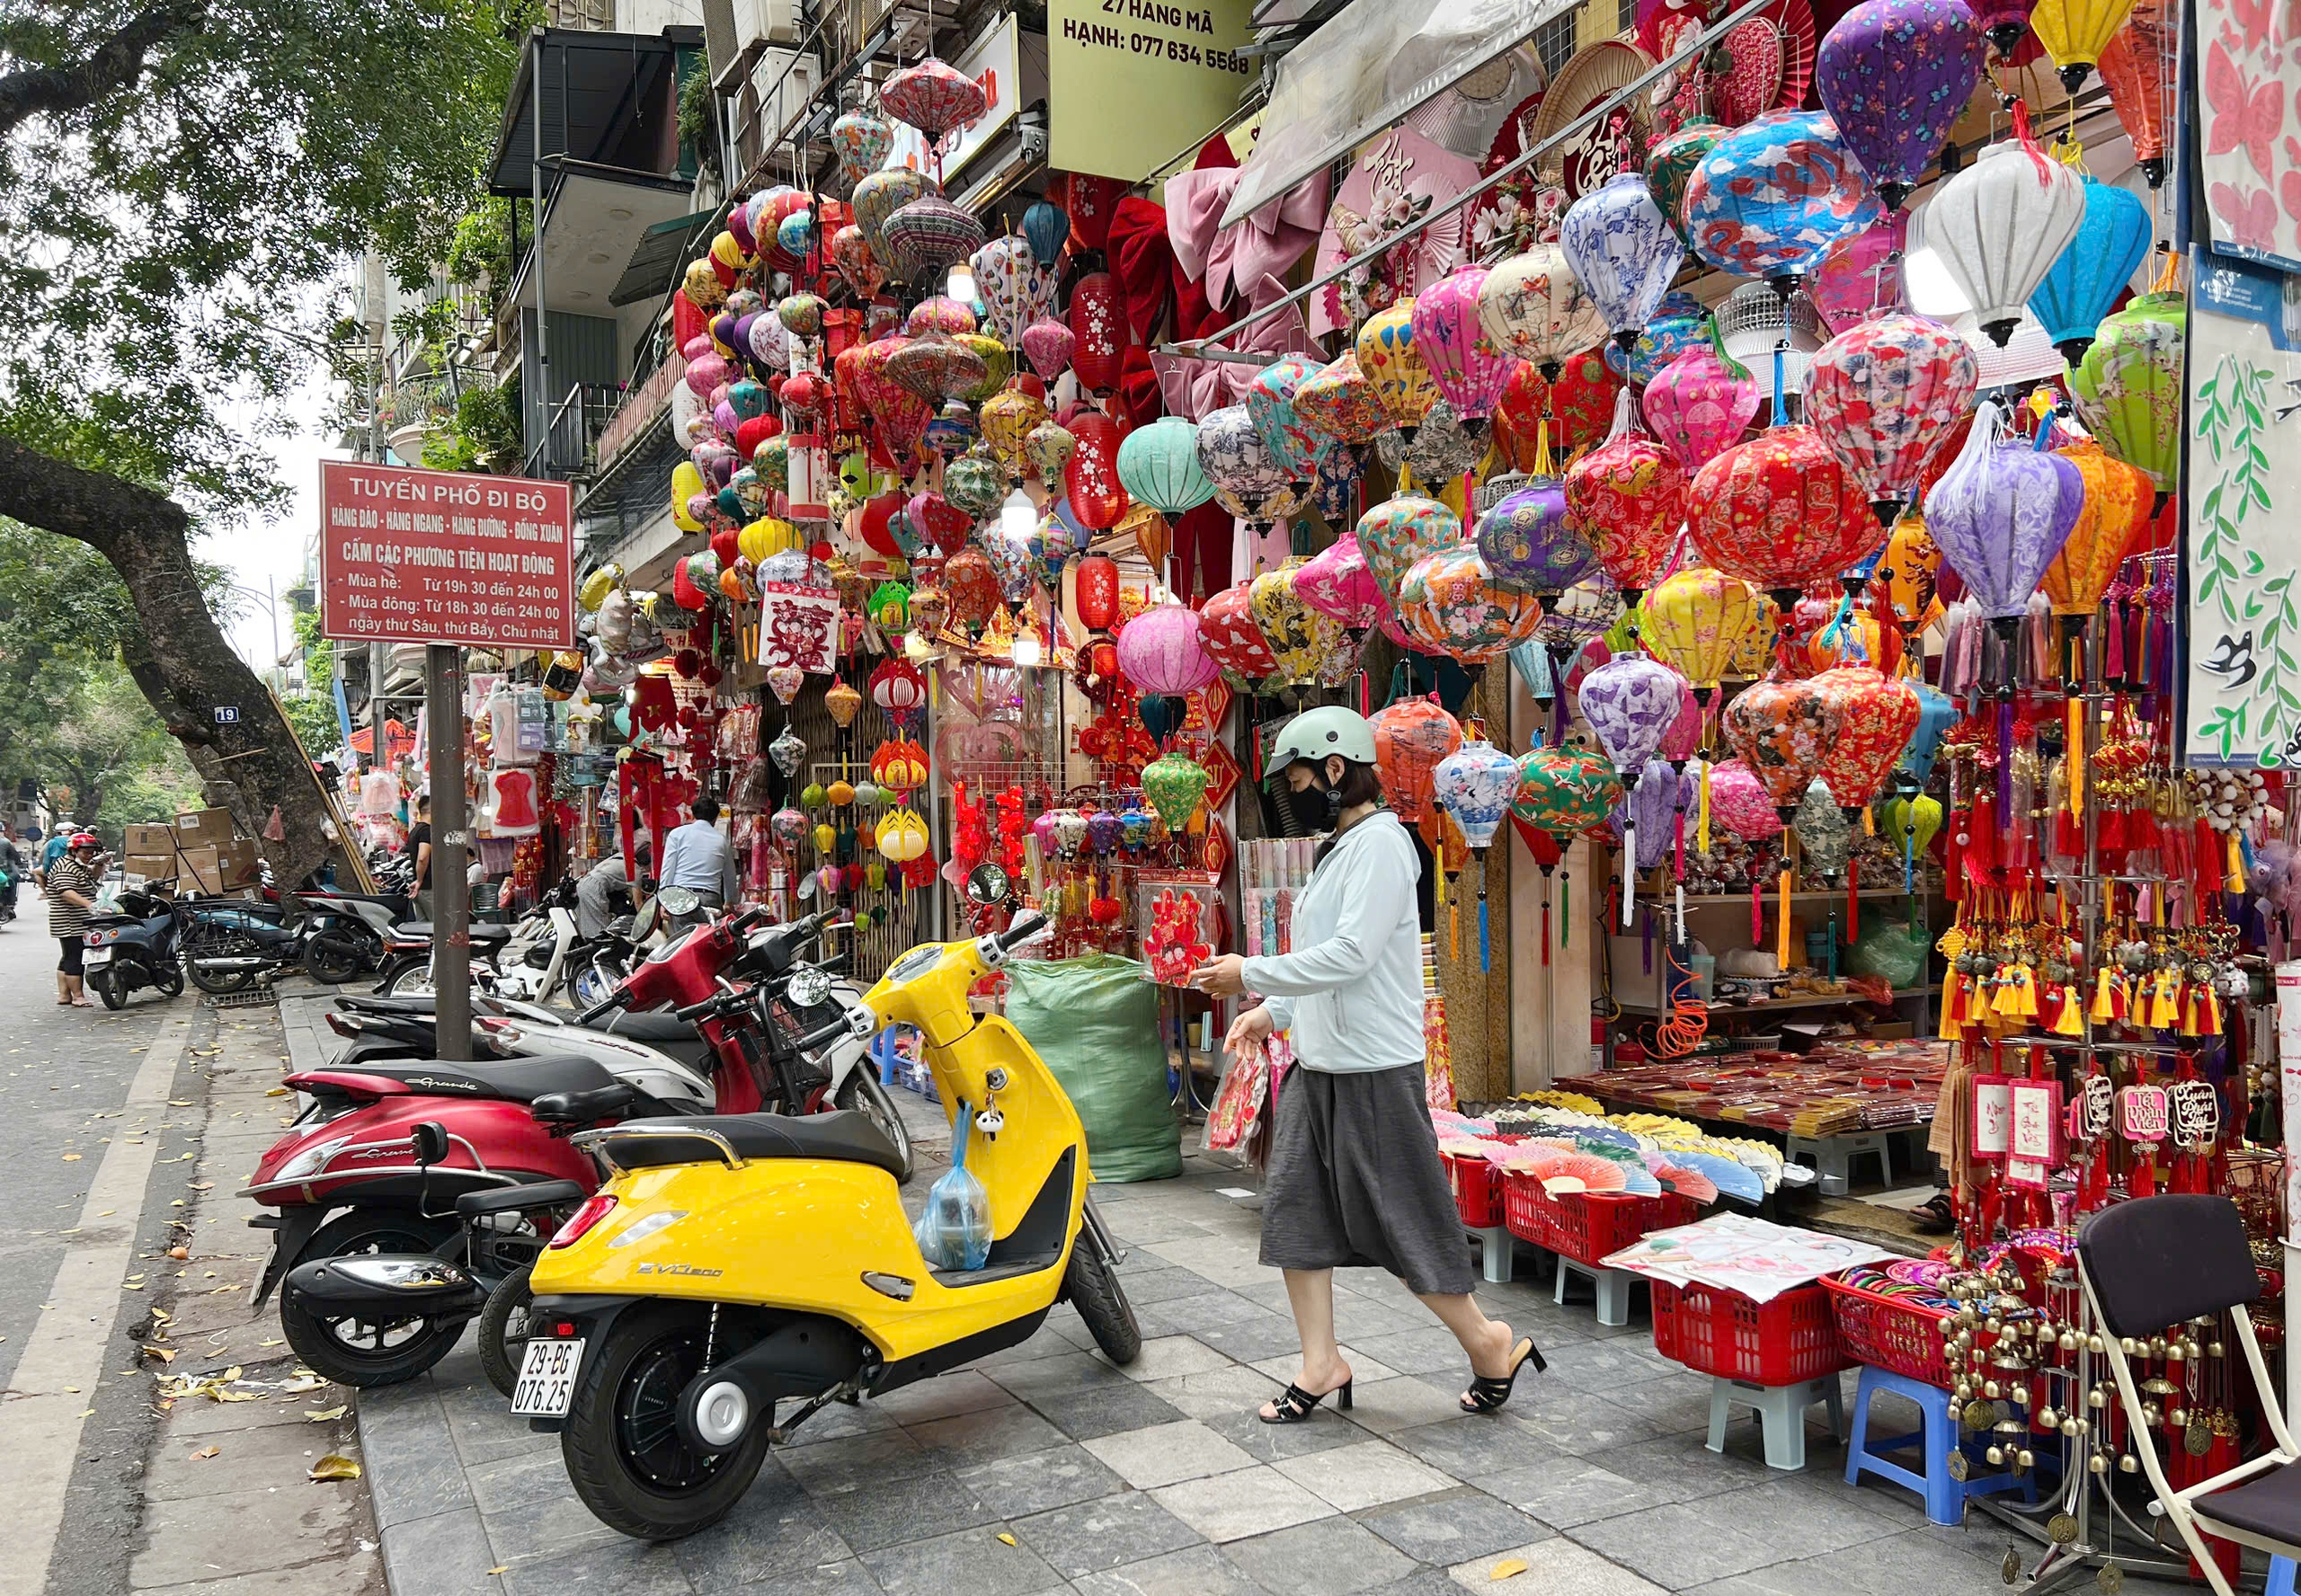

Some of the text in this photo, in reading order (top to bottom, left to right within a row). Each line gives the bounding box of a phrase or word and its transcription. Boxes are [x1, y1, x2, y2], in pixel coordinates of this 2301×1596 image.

[1186, 10, 1214, 35] MÃ
[1063, 18, 1249, 75] HẠNH: 077 634 5588
[349, 476, 546, 516] TUYẾN PHỐ ĐI BỘ
[332, 502, 358, 528] HÀNG
[360, 505, 378, 528] ĐÀO
[386, 507, 411, 531] HÀNG
[413, 513, 444, 534] NGANG
[451, 512, 476, 536] HÀNG
[477, 514, 507, 538] ĐƯỜNG
[539, 520, 564, 544] XUÂN
[342, 537, 555, 579] CẤM CÁC PHƯƠNG TIỆN HOẠT ĐỘNG
[348, 572, 377, 588] Mùa
[380, 574, 402, 590] hè:
[422, 577, 441, 591] Từ
[444, 580, 467, 593] 19h
[471, 581, 486, 594] 30
[490, 581, 514, 597] đến
[517, 584, 540, 598] 24h
[544, 586, 558, 599] 00
[349, 594, 378, 609] Mùa
[381, 595, 420, 615] đông:
[424, 598, 443, 613] Từ
[445, 600, 468, 615] 18h
[472, 602, 487, 615] 30
[491, 601, 515, 616] đến
[519, 605, 542, 618] 24h
[545, 607, 560, 620] 00
[349, 616, 382, 633] ngày
[412, 618, 440, 635] Sáu,
[444, 621, 467, 634] thứ
[470, 618, 498, 639] Bẩy,
[501, 622, 528, 638] Chủ
[531, 626, 559, 643] nhật
[218, 708, 235, 721] 19
[404, 1077, 478, 1091] Grande
[2177, 1086, 2214, 1102] Xuân
[2134, 1092, 2158, 1107] Tết
[2181, 1099, 2213, 1116] Phát
[527, 1343, 573, 1375] 29-BG
[515, 1379, 570, 1412] 076.25
